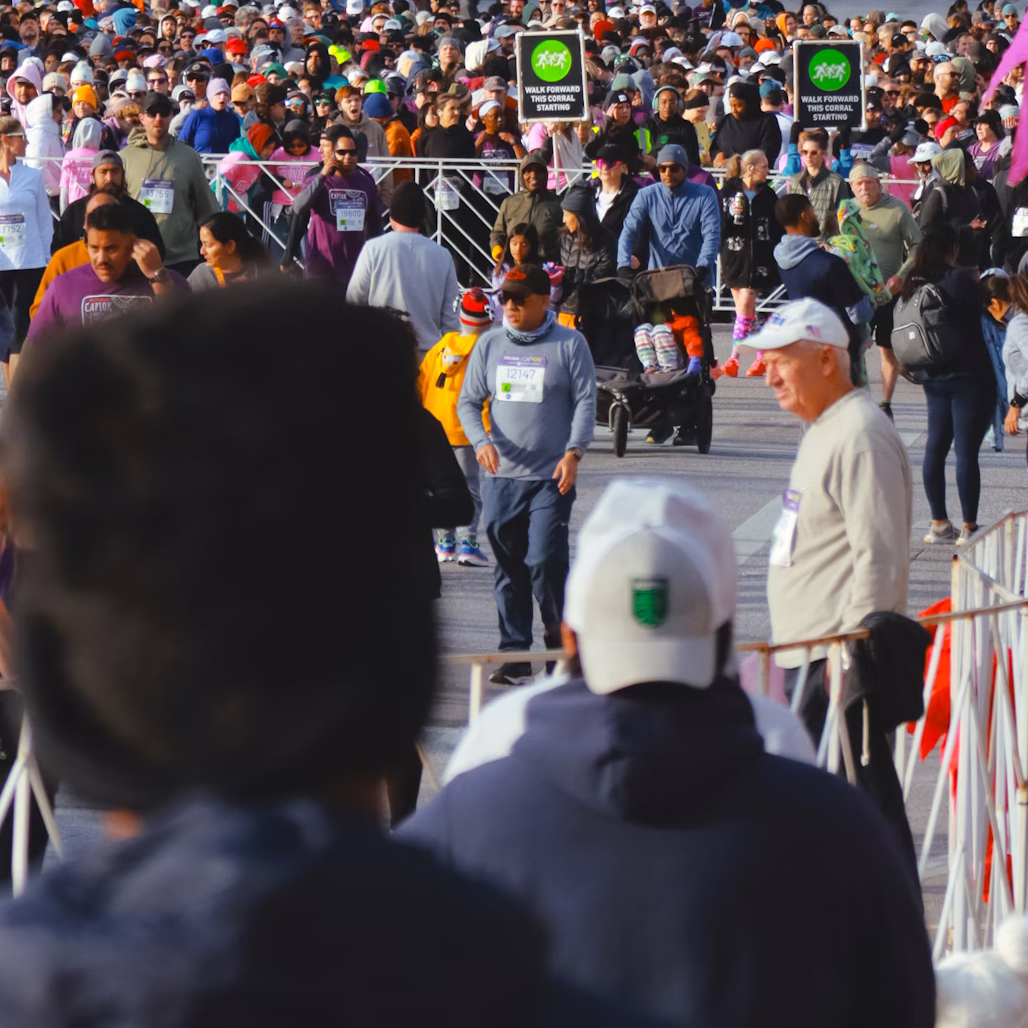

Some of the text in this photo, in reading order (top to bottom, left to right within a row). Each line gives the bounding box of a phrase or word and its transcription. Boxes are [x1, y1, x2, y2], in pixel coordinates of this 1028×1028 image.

[524, 85, 581, 94] WALK FORWARD
[530, 94, 576, 103] THIS CORRAL
[823, 95, 859, 103] FORWARD
[536, 103, 571, 112] STARTING
[807, 104, 853, 112] THIS CORRAL
[812, 113, 848, 121] STARTING
[506, 368, 537, 380] 12147
